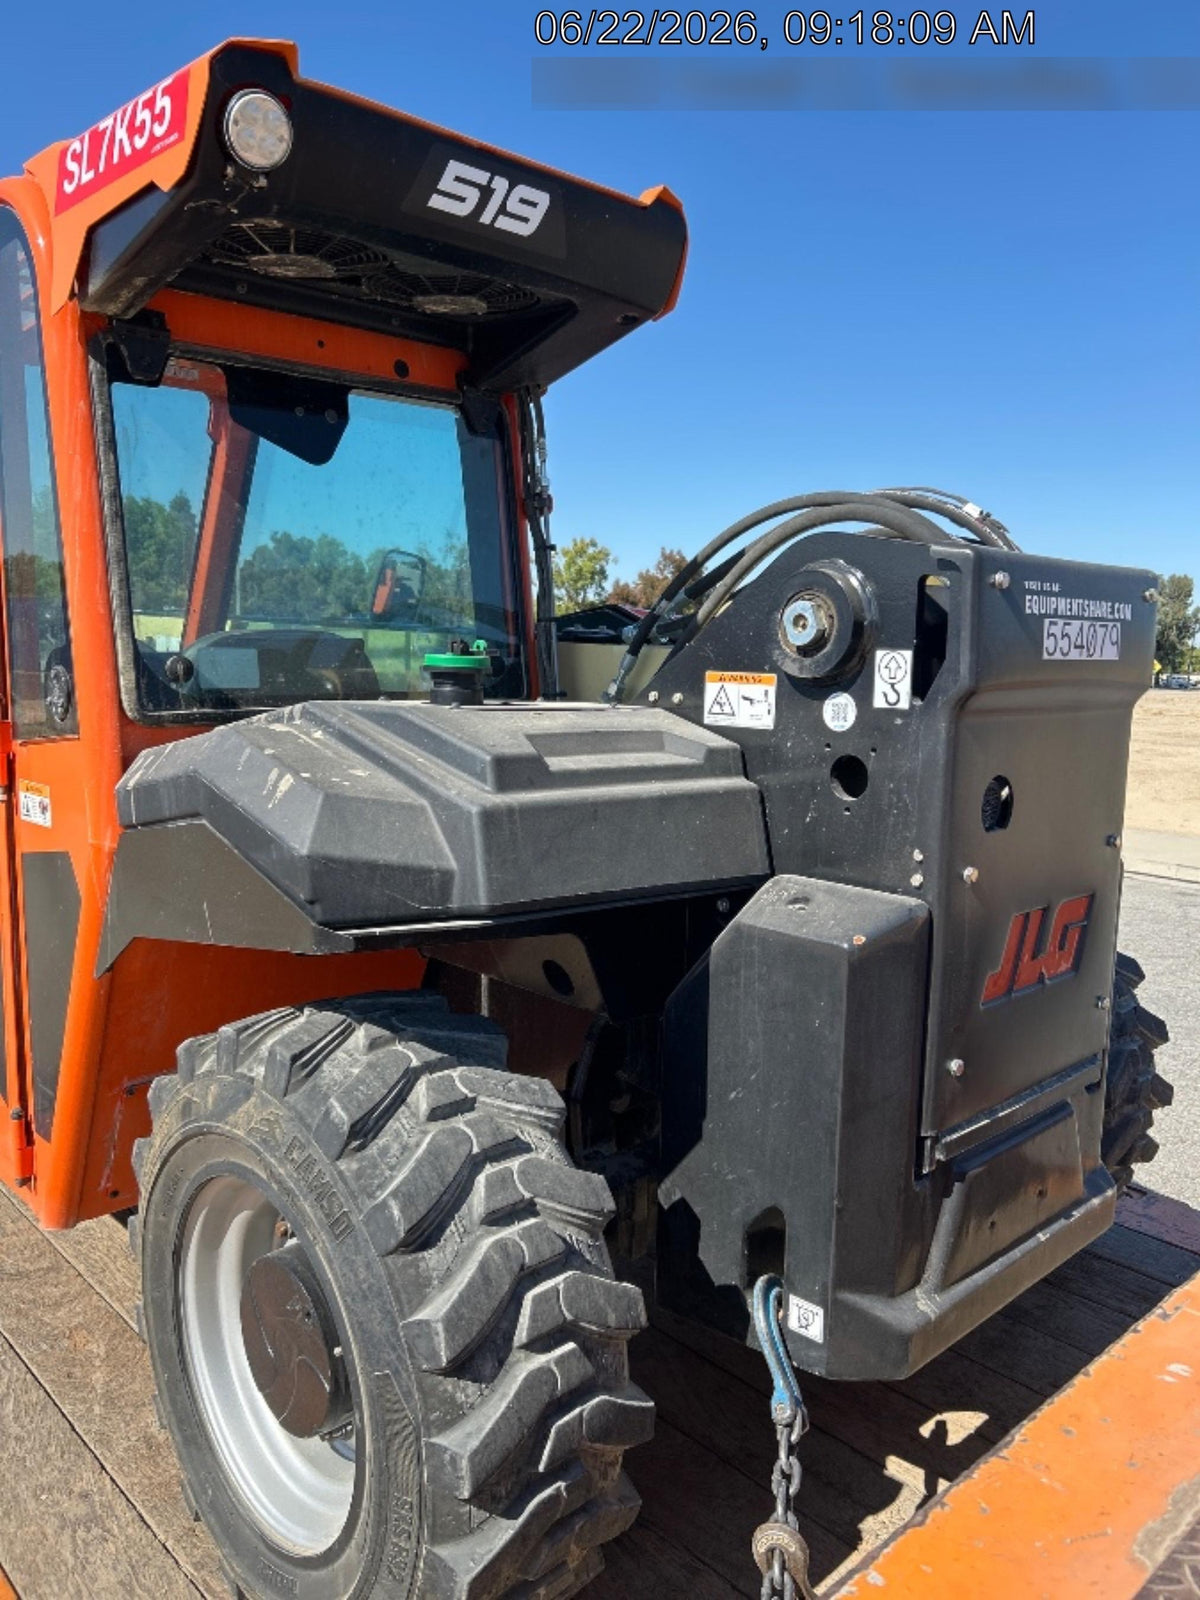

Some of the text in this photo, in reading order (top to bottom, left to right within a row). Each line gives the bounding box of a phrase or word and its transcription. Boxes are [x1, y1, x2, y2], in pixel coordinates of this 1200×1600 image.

[63, 76, 173, 195] SL7K55
[426, 159, 551, 237] 519
[1045, 620, 1120, 658] 554079
[980, 893, 1094, 1009] JLG
